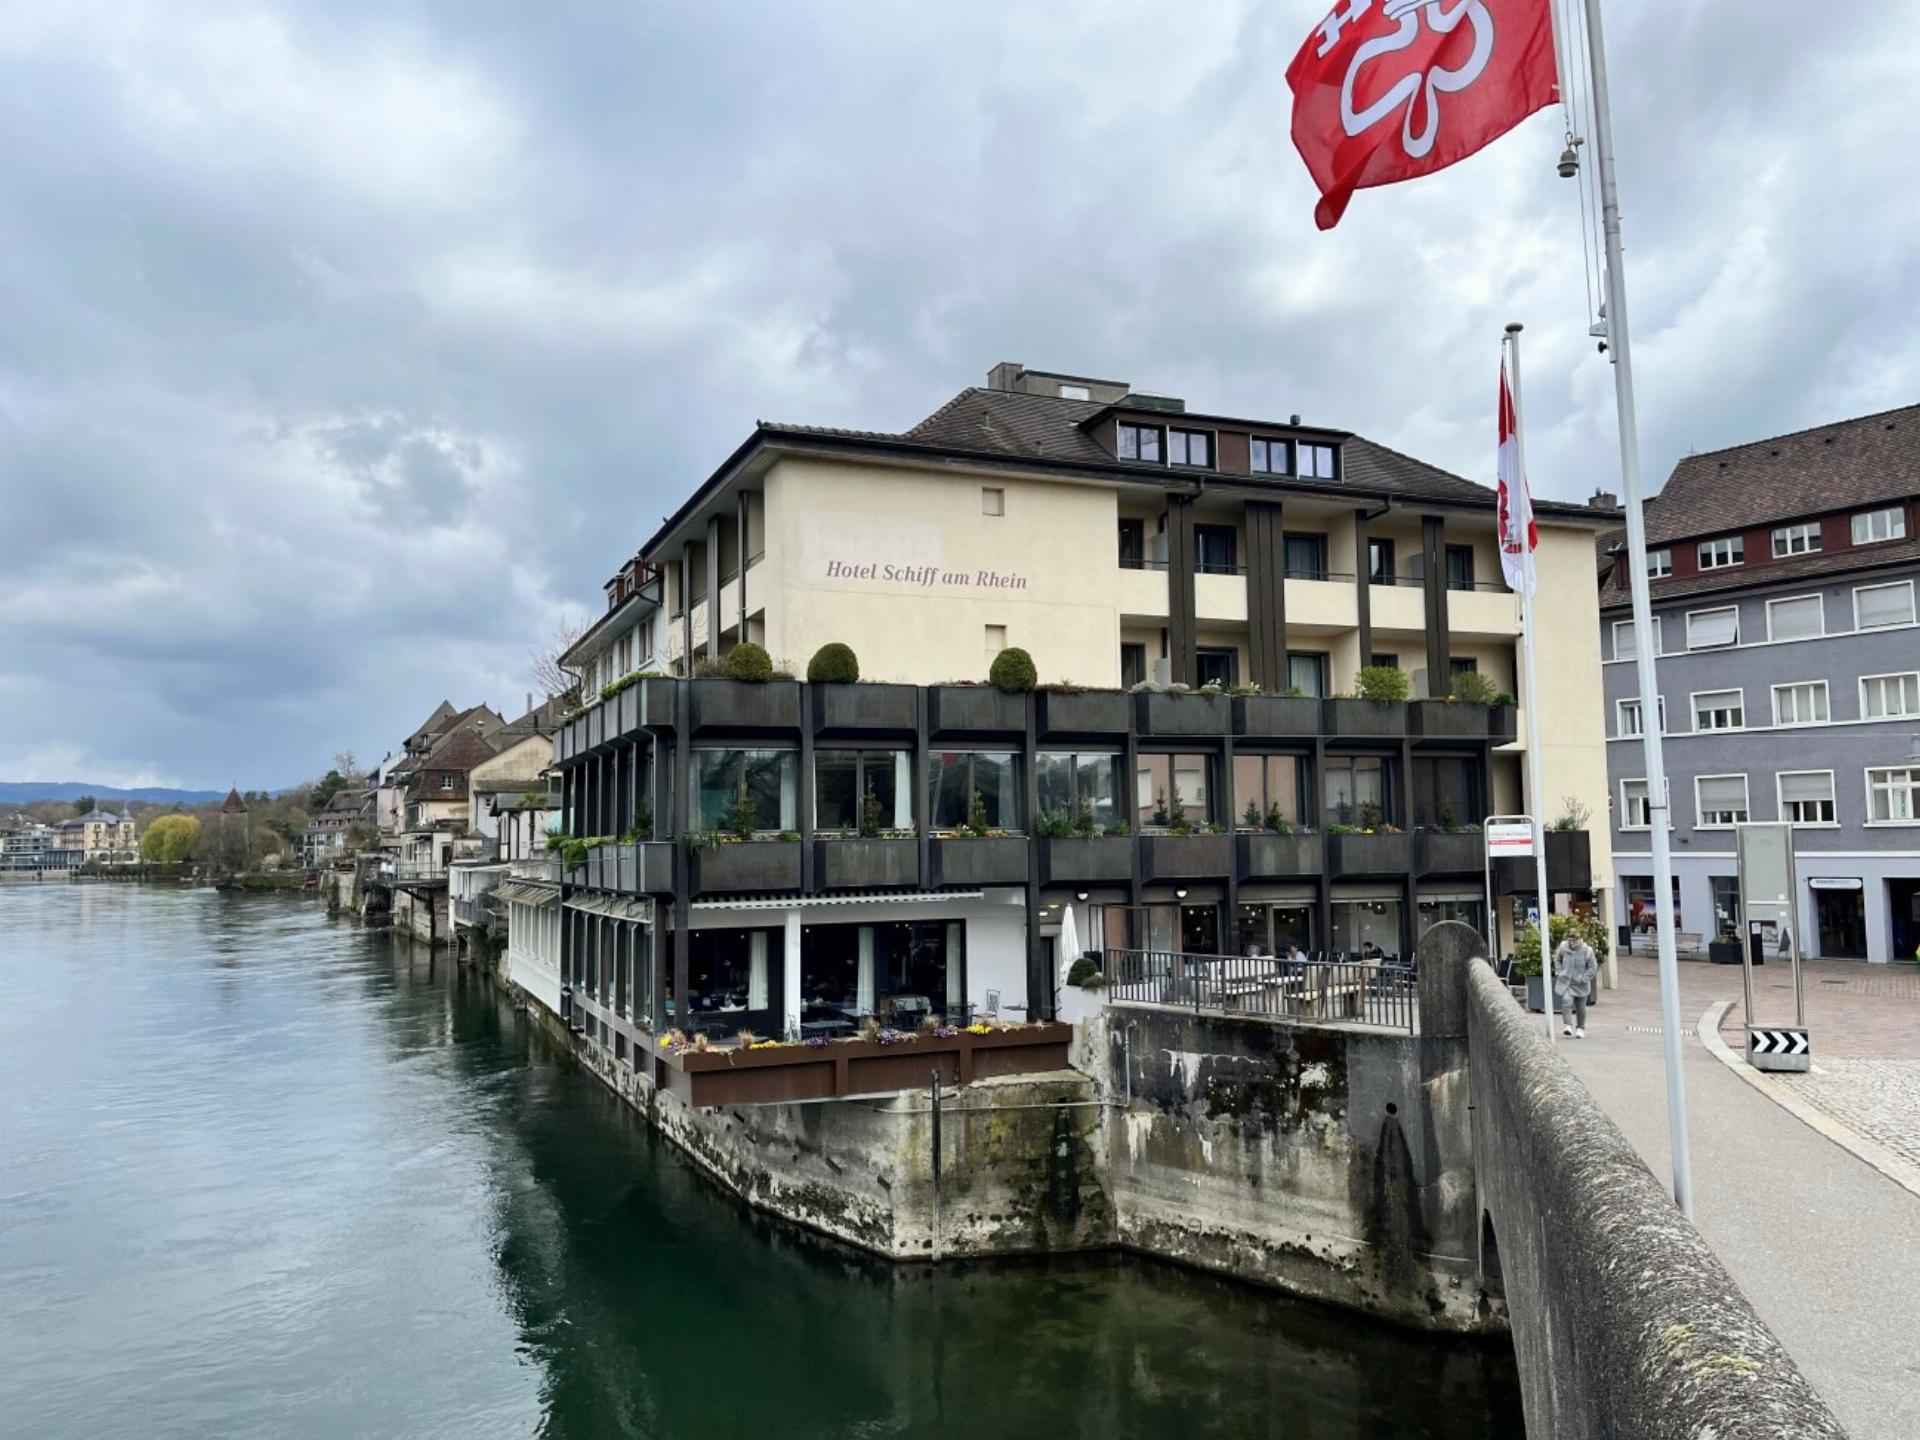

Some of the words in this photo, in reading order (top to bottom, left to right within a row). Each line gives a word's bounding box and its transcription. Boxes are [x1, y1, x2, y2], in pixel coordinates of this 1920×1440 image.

[826, 560, 877, 579] Hotel
[882, 564, 939, 586] Schiff
[942, 572, 969, 585] am
[976, 570, 1026, 589] Rhein
